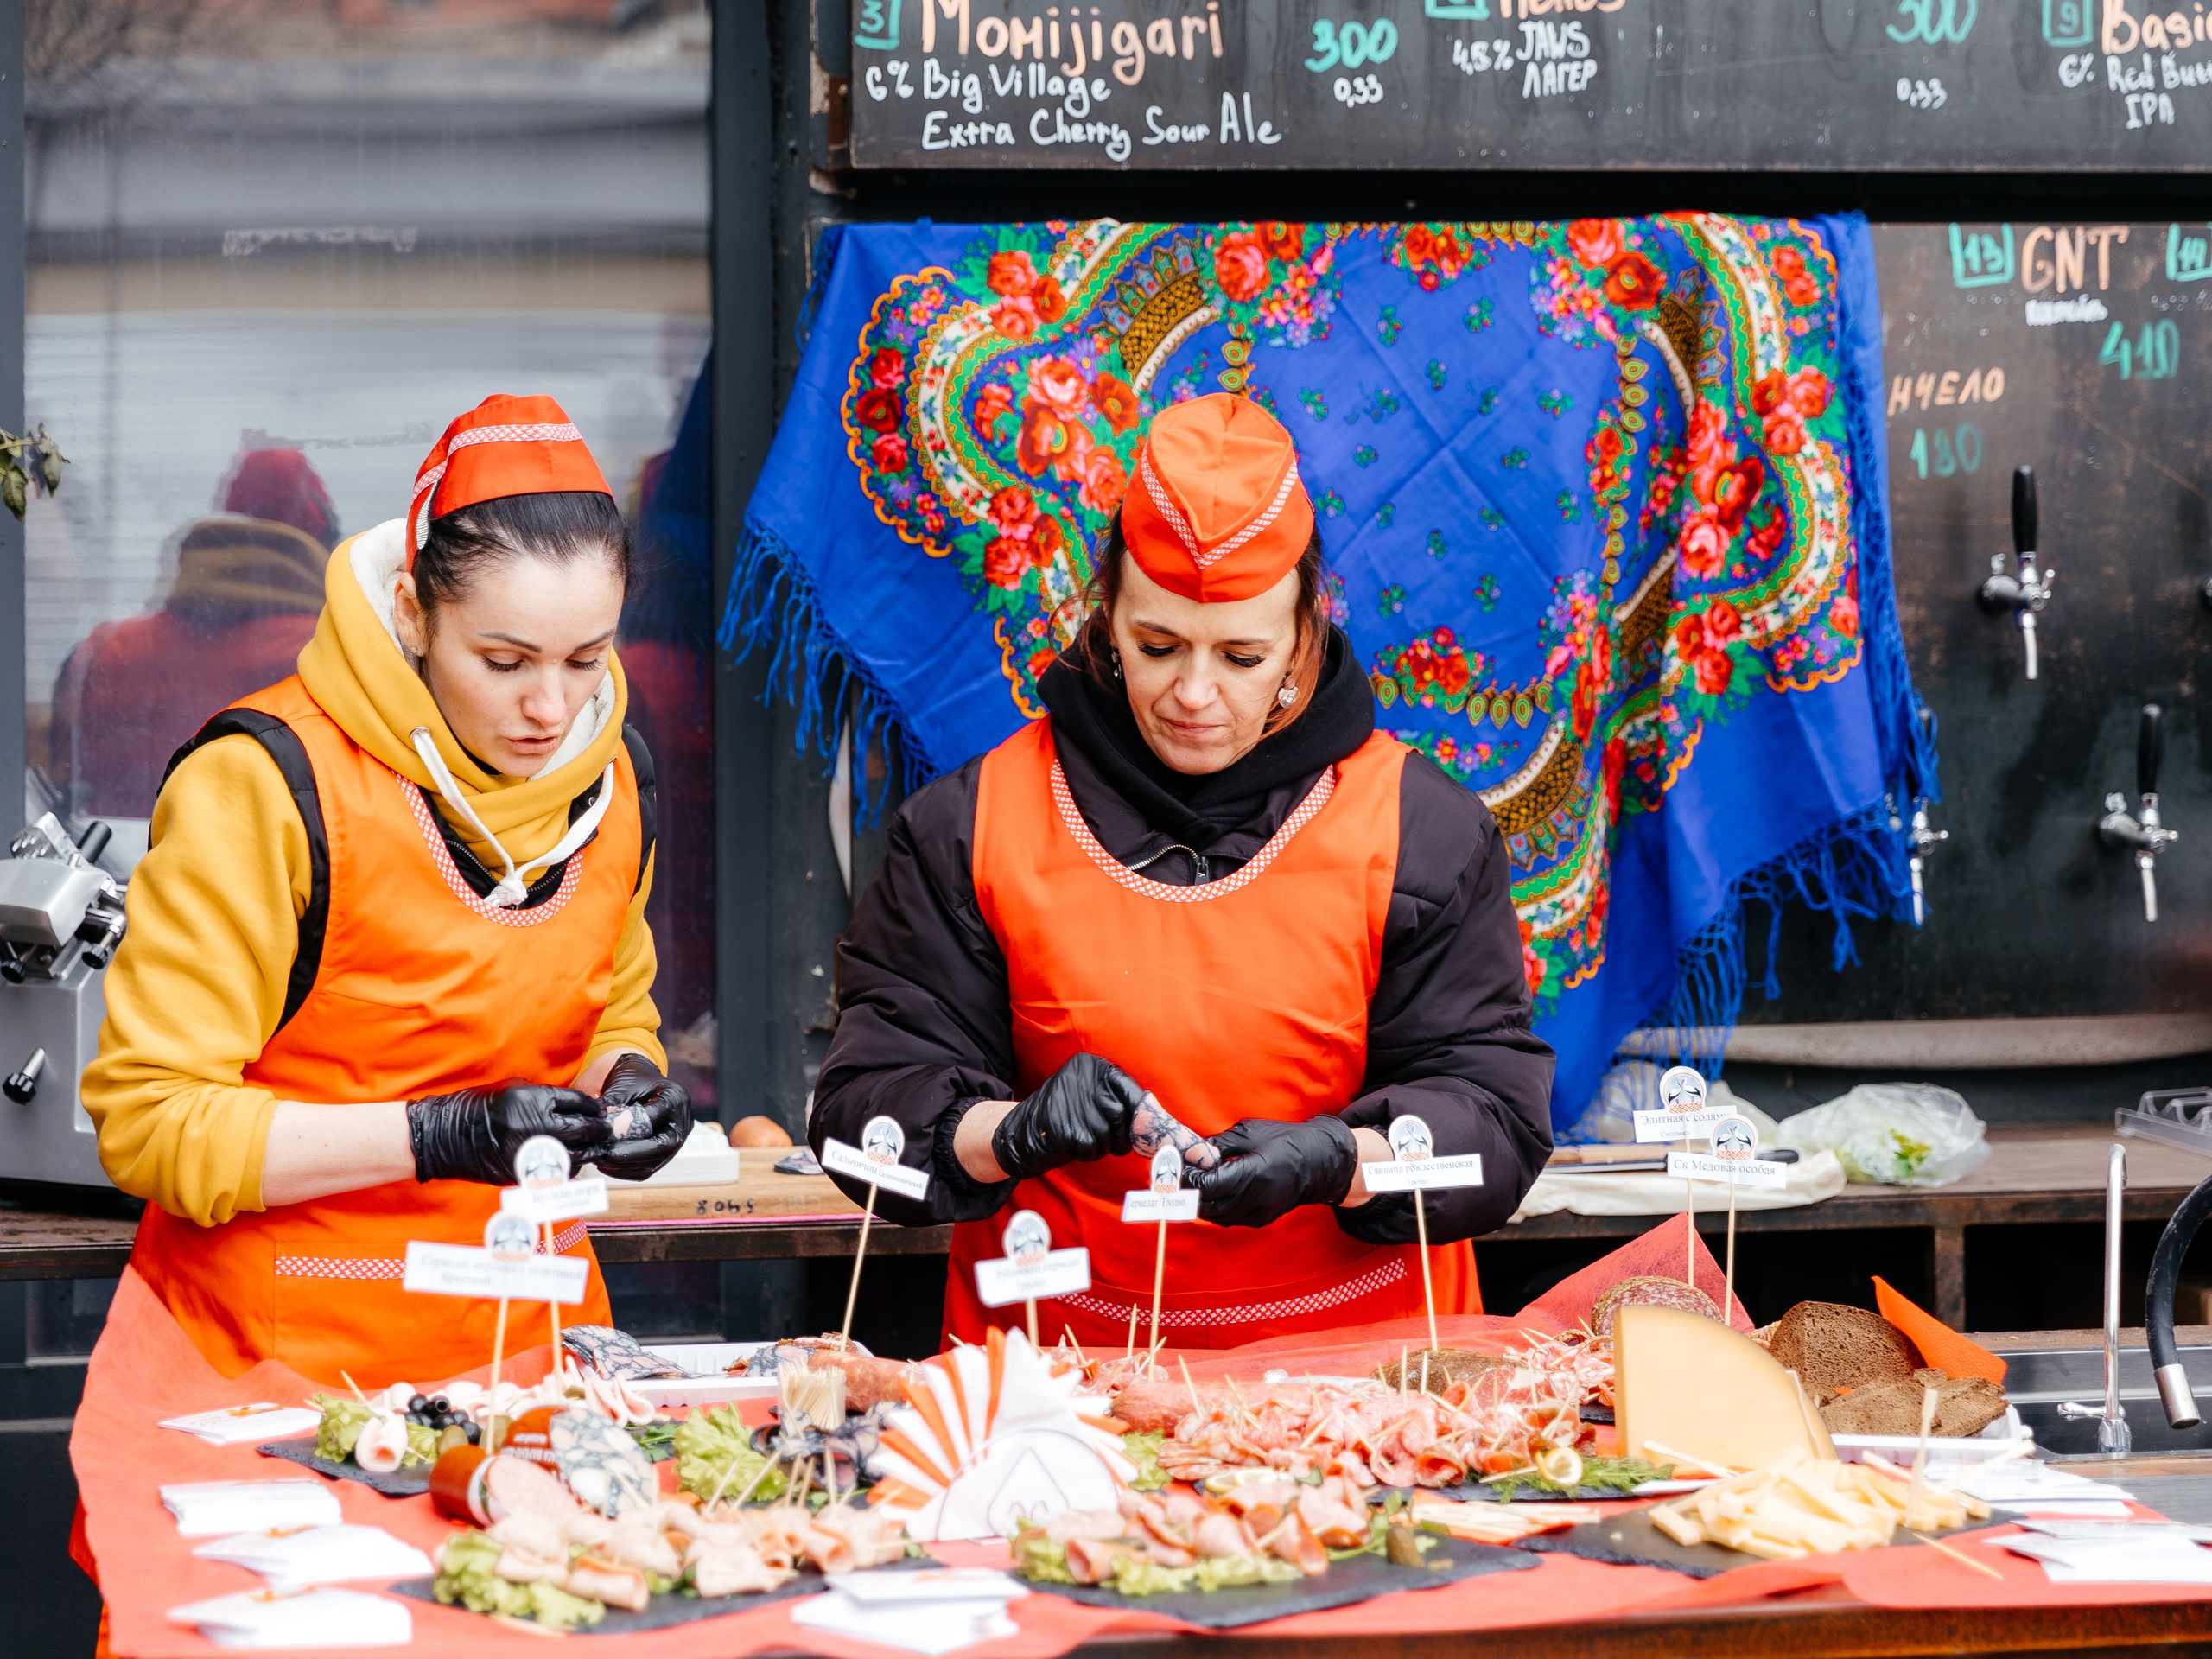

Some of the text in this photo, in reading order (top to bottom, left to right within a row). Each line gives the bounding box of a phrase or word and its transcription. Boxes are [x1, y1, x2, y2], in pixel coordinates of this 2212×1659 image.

[2057, 3, 2080, 35] 9
[2101, 0, 2212, 55] Basi
[1305, 17, 1398, 73] 300
[1516, 20, 1590, 61] JAWS
[866, 58, 1111, 118] 6% Big Village
[1333, 74, 1383, 108] 0,33
[1522, 59, 1598, 99] ЛАГЕР
[2058, 52, 2096, 88] 6%
[2107, 52, 2156, 94] Red
[1897, 77, 1948, 110] 0,33
[2125, 92, 2175, 130] IPA
[921, 91, 1282, 162] Extra Cherry Sour Ale
[1964, 233, 2005, 273] 13
[2021, 225, 2129, 293] GNT
[2098, 318, 2180, 380] 410
[1693, 1113, 1728, 1122] солям
[1691, 1161, 1736, 1173] Медовая
[1739, 1165, 1776, 1175] особая
